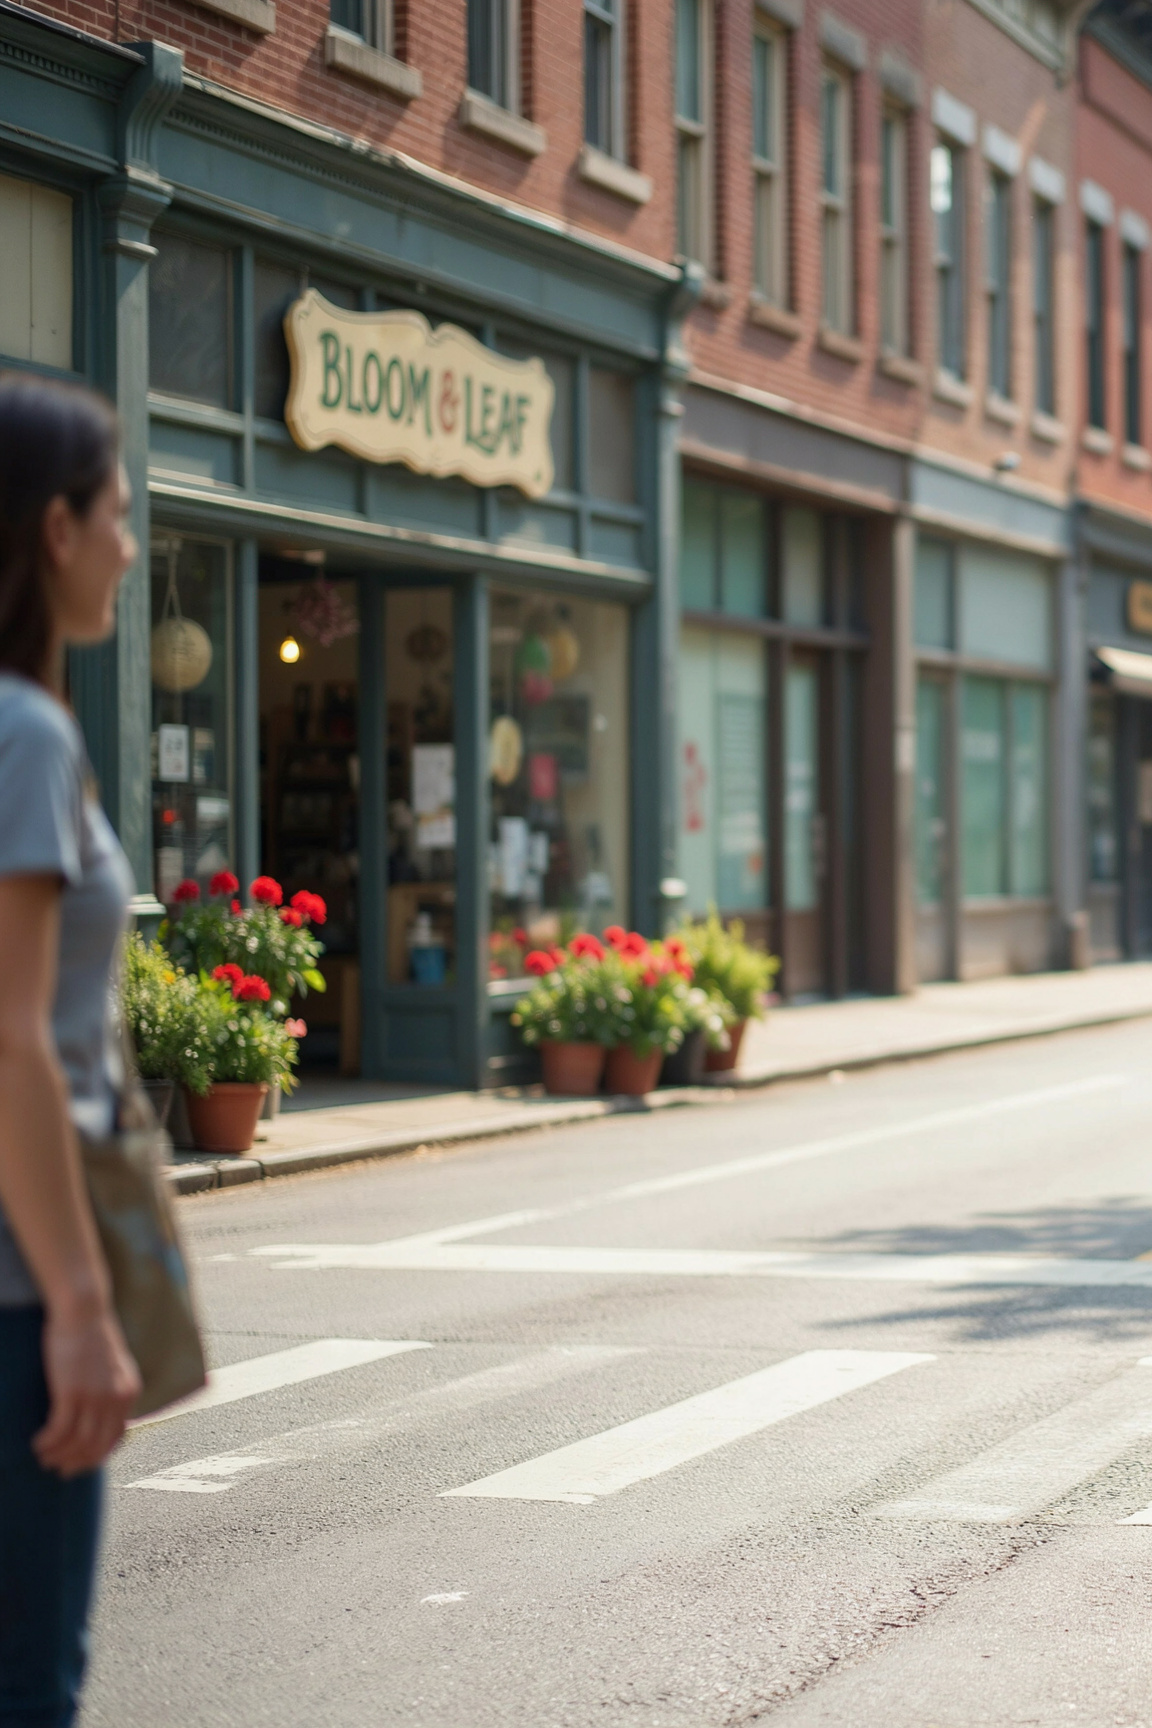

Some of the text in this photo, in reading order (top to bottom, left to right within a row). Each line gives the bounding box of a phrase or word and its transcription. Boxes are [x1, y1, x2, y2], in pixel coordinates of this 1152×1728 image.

[319, 329, 531, 457] BLOOM & LEAF
